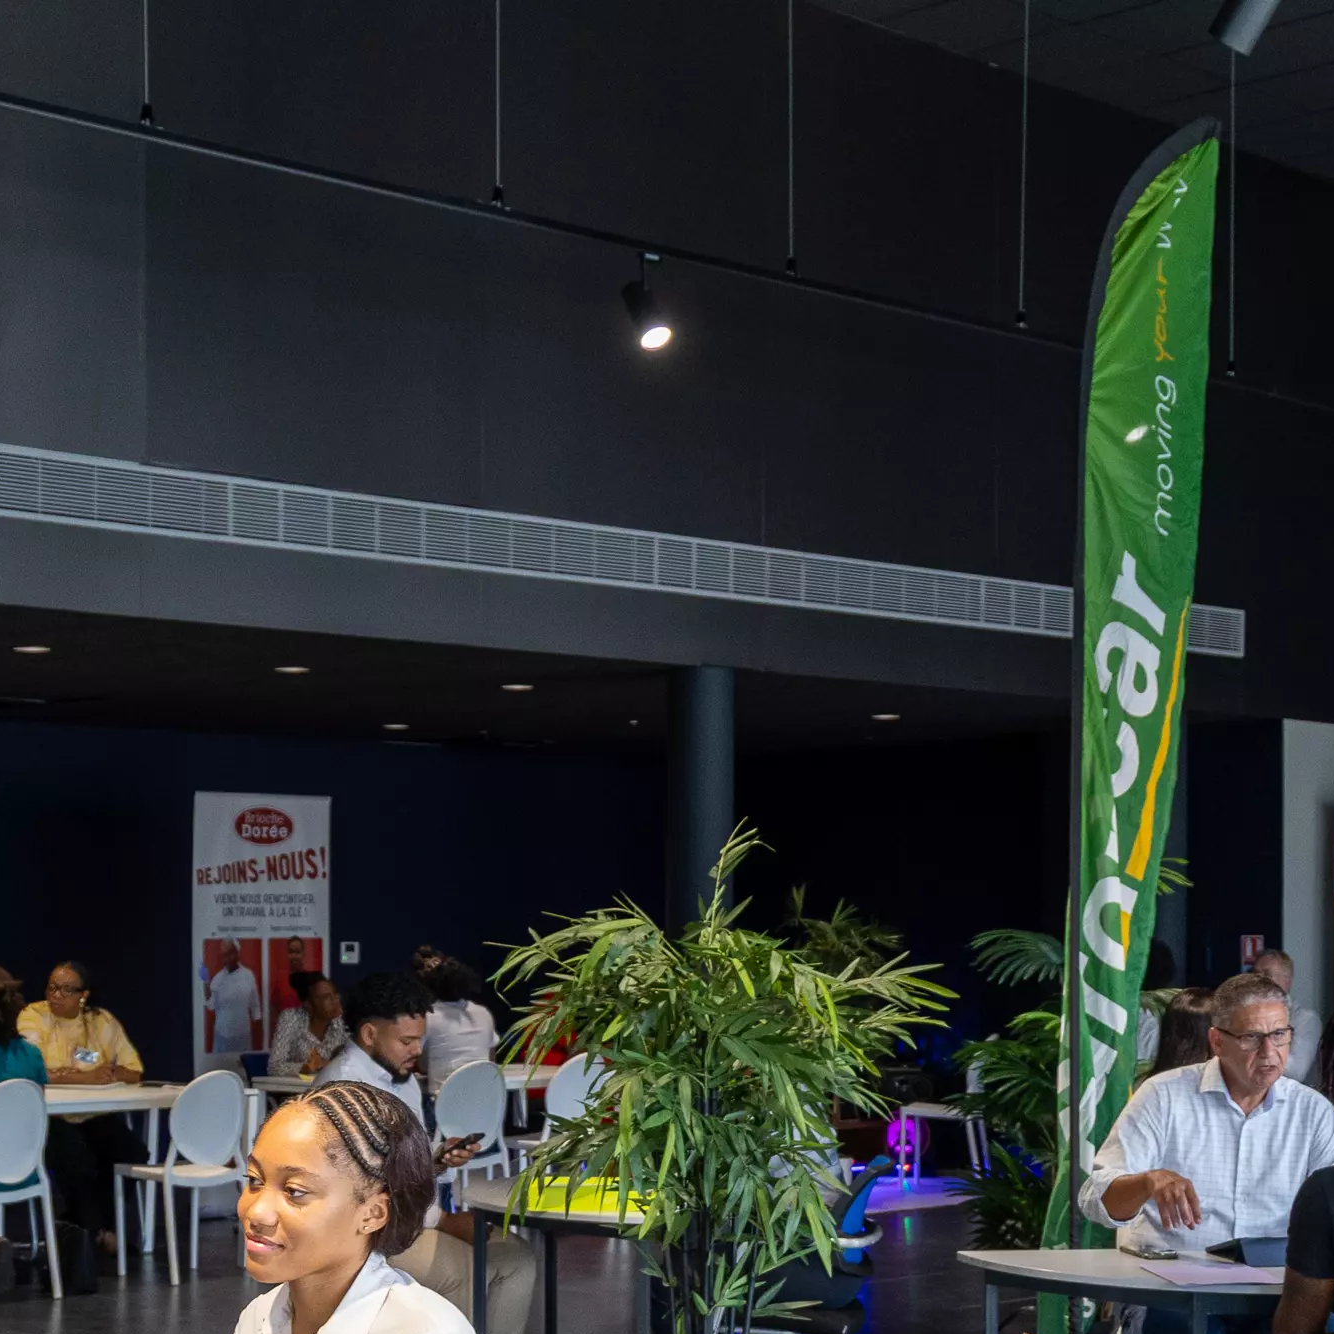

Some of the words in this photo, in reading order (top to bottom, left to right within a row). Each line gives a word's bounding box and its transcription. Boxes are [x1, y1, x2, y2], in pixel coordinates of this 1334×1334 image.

[1154, 257, 1175, 362] your
[1153, 374, 1177, 537] moving
[241, 823, 288, 838] Dorée
